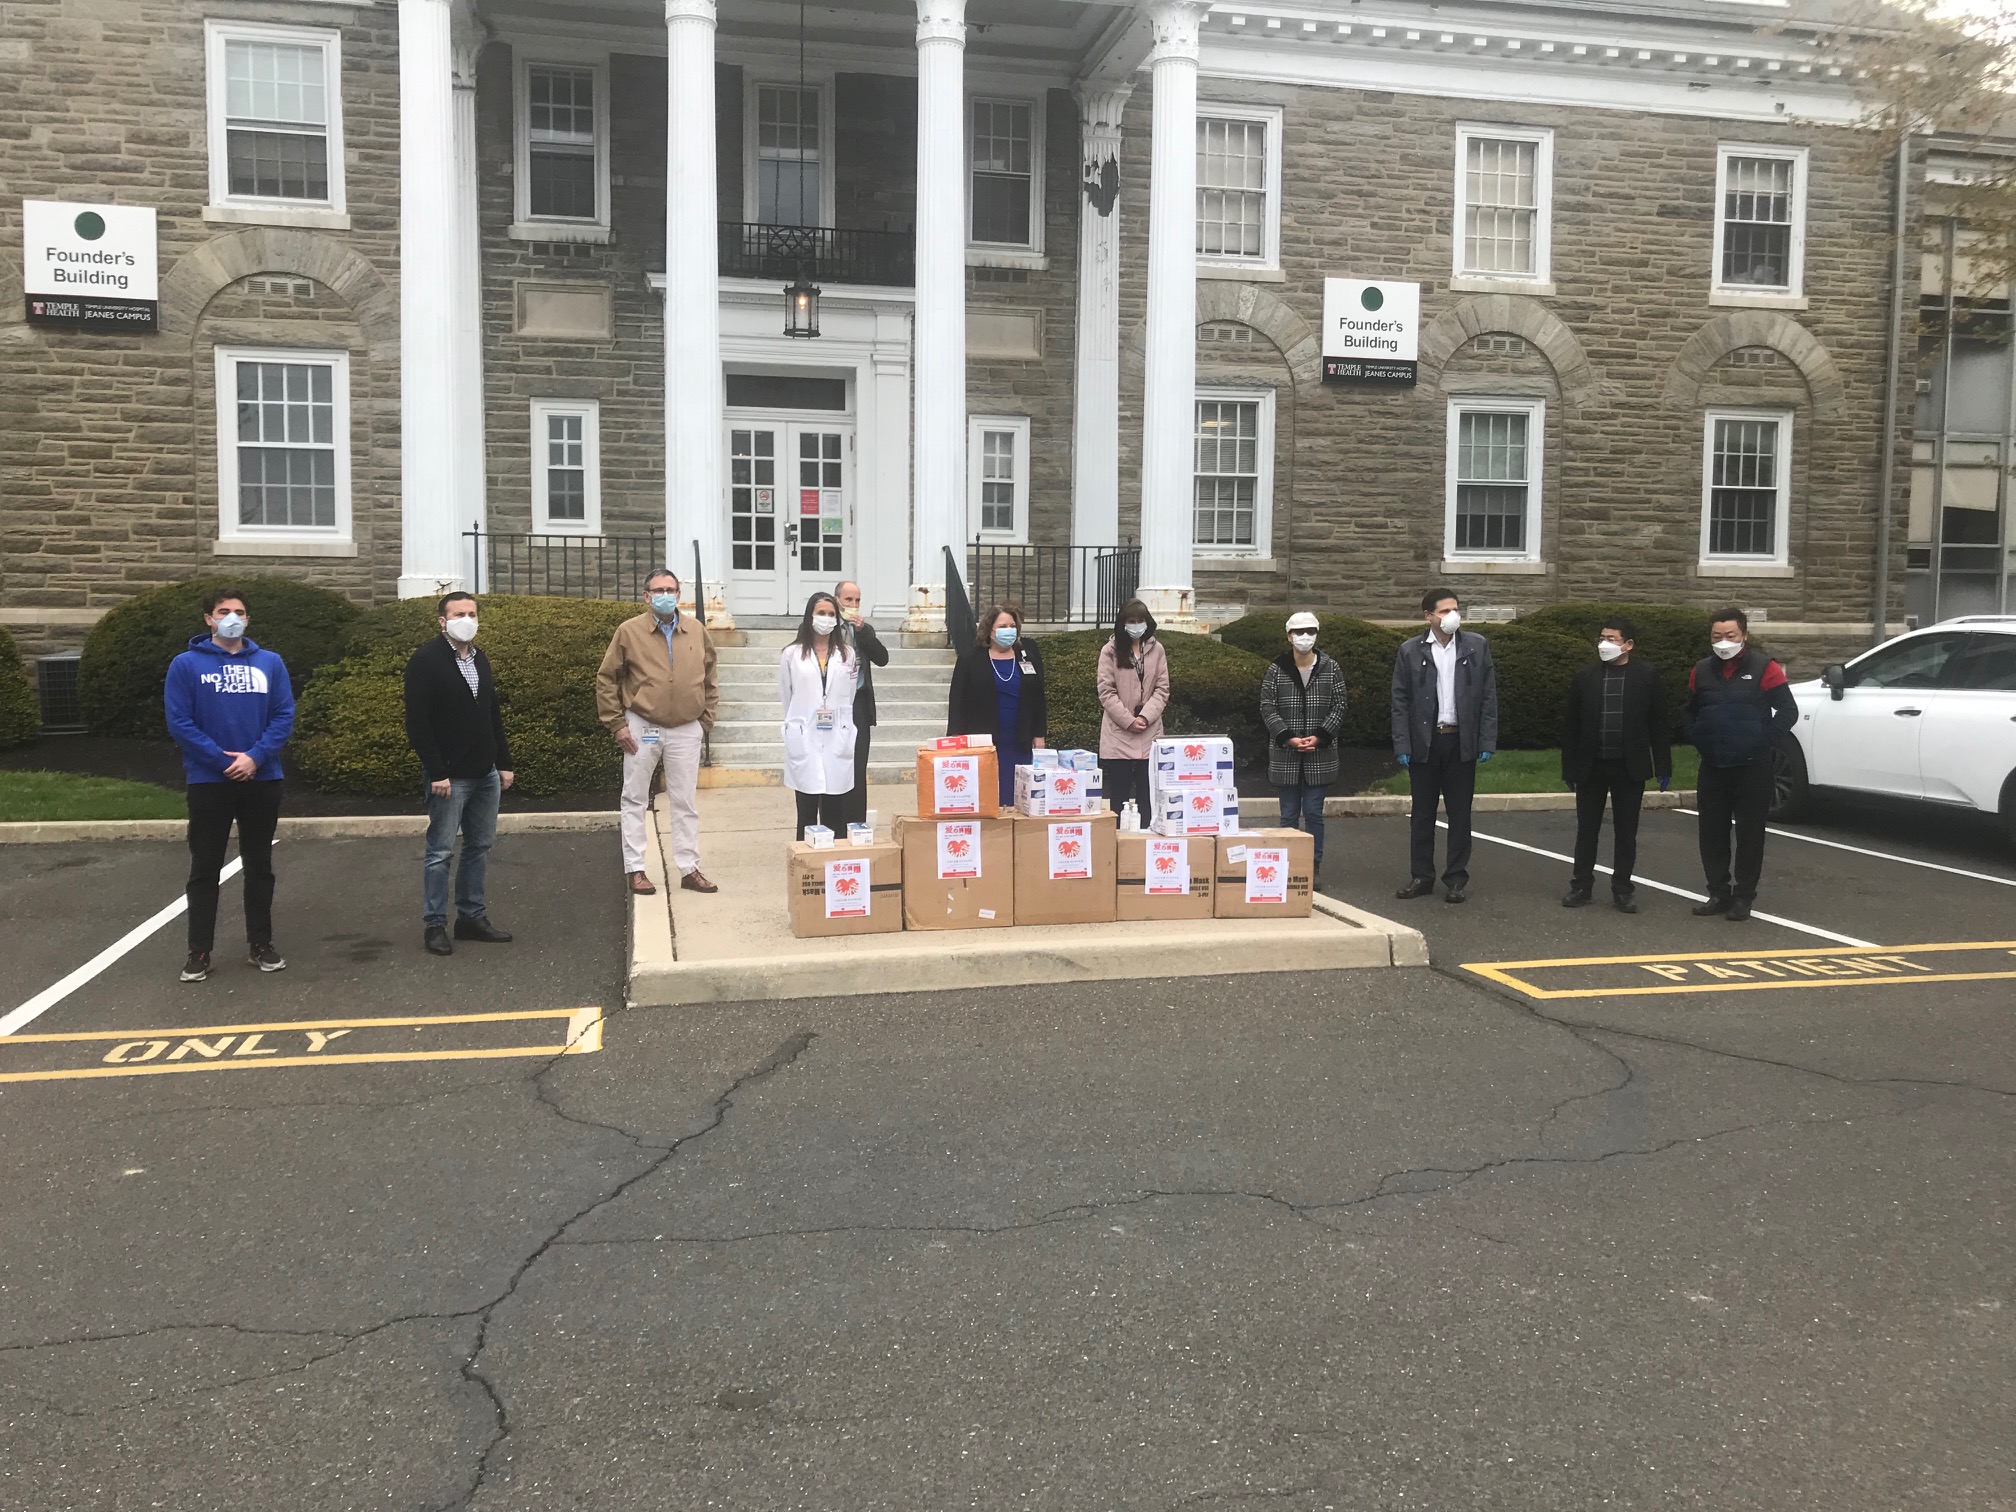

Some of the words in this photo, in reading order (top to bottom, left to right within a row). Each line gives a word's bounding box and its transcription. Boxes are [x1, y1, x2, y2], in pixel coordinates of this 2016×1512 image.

[46, 247, 135, 266] Founder's
[53, 268, 129, 290] Building
[45, 301, 79, 310] TEMPLE
[46, 308, 80, 317] HEALTH
[84, 310, 115, 320] JEANES
[116, 312, 151, 321] CAMPUS
[1339, 317, 1403, 332] Founder's
[1344, 334, 1398, 352] Building
[1337, 363, 1361, 371] TEMPLE
[1364, 370, 1386, 378] JEANES
[1387, 371, 1412, 379] CAMPUS
[222, 664, 245, 675] THE
[215, 682, 247, 693] FACE
[1222, 746, 1229, 755] S
[1092, 774, 1100, 783] M
[1227, 794, 1235, 802] M
[1640, 956, 1933, 981] PATIENT
[102, 1029, 352, 1063] ONLY
